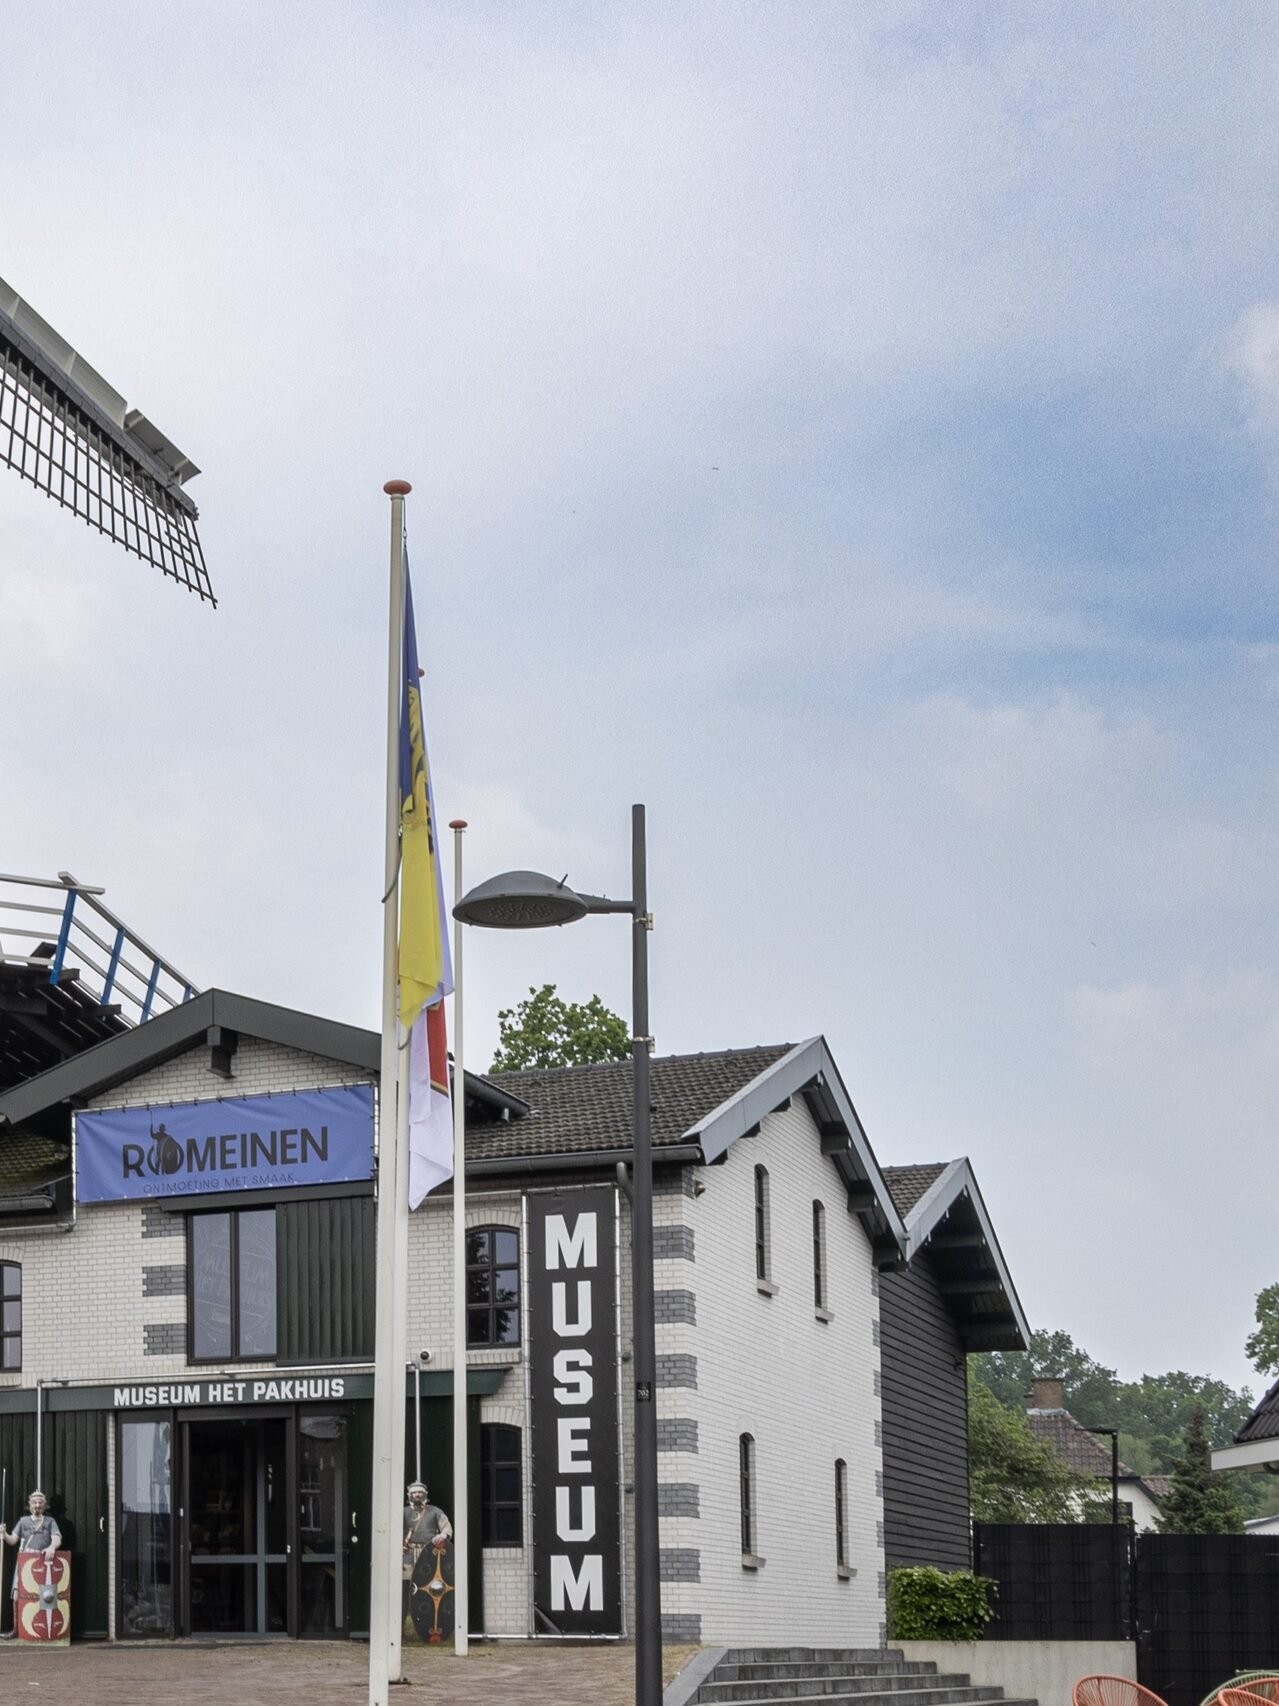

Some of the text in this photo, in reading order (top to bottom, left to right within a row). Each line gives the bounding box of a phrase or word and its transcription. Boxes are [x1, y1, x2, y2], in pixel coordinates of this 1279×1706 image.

[123, 1126, 329, 1178] ROMEINEN
[143, 1172, 295, 1194] ONTMOETING MET SMAAK
[114, 1378, 344, 1406] MUSEUM HET PAKHUIS
[544, 1212, 604, 1611] MUSEUM
